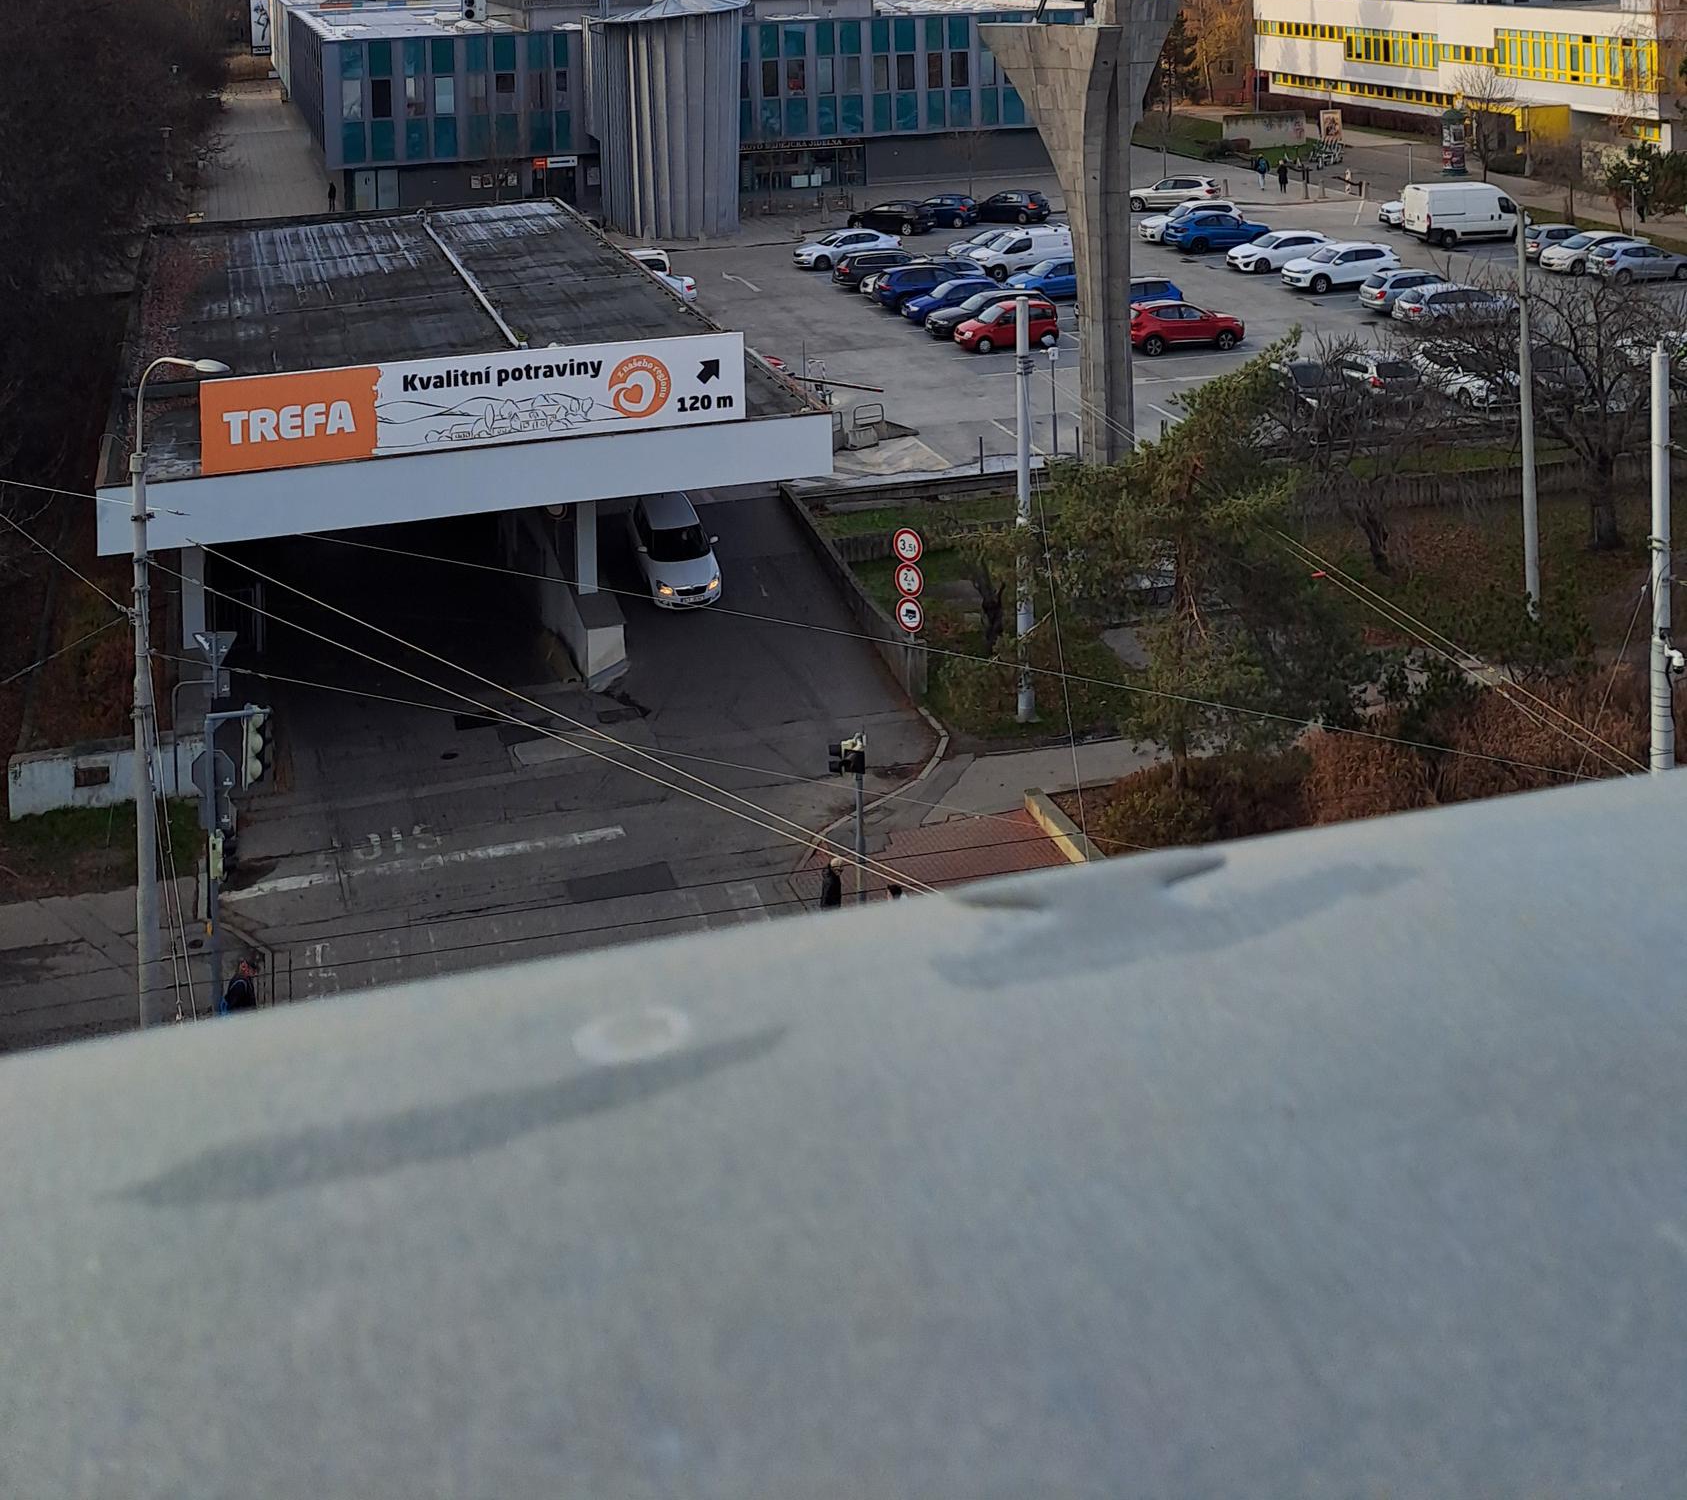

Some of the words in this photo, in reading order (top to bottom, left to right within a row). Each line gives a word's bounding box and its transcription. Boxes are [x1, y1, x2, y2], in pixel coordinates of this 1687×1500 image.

[402, 366, 492, 392] Kvalitní
[497, 358, 603, 387] potraviny
[677, 394, 712, 412] 120
[716, 395, 733, 409] m
[223, 400, 356, 445] TREFA
